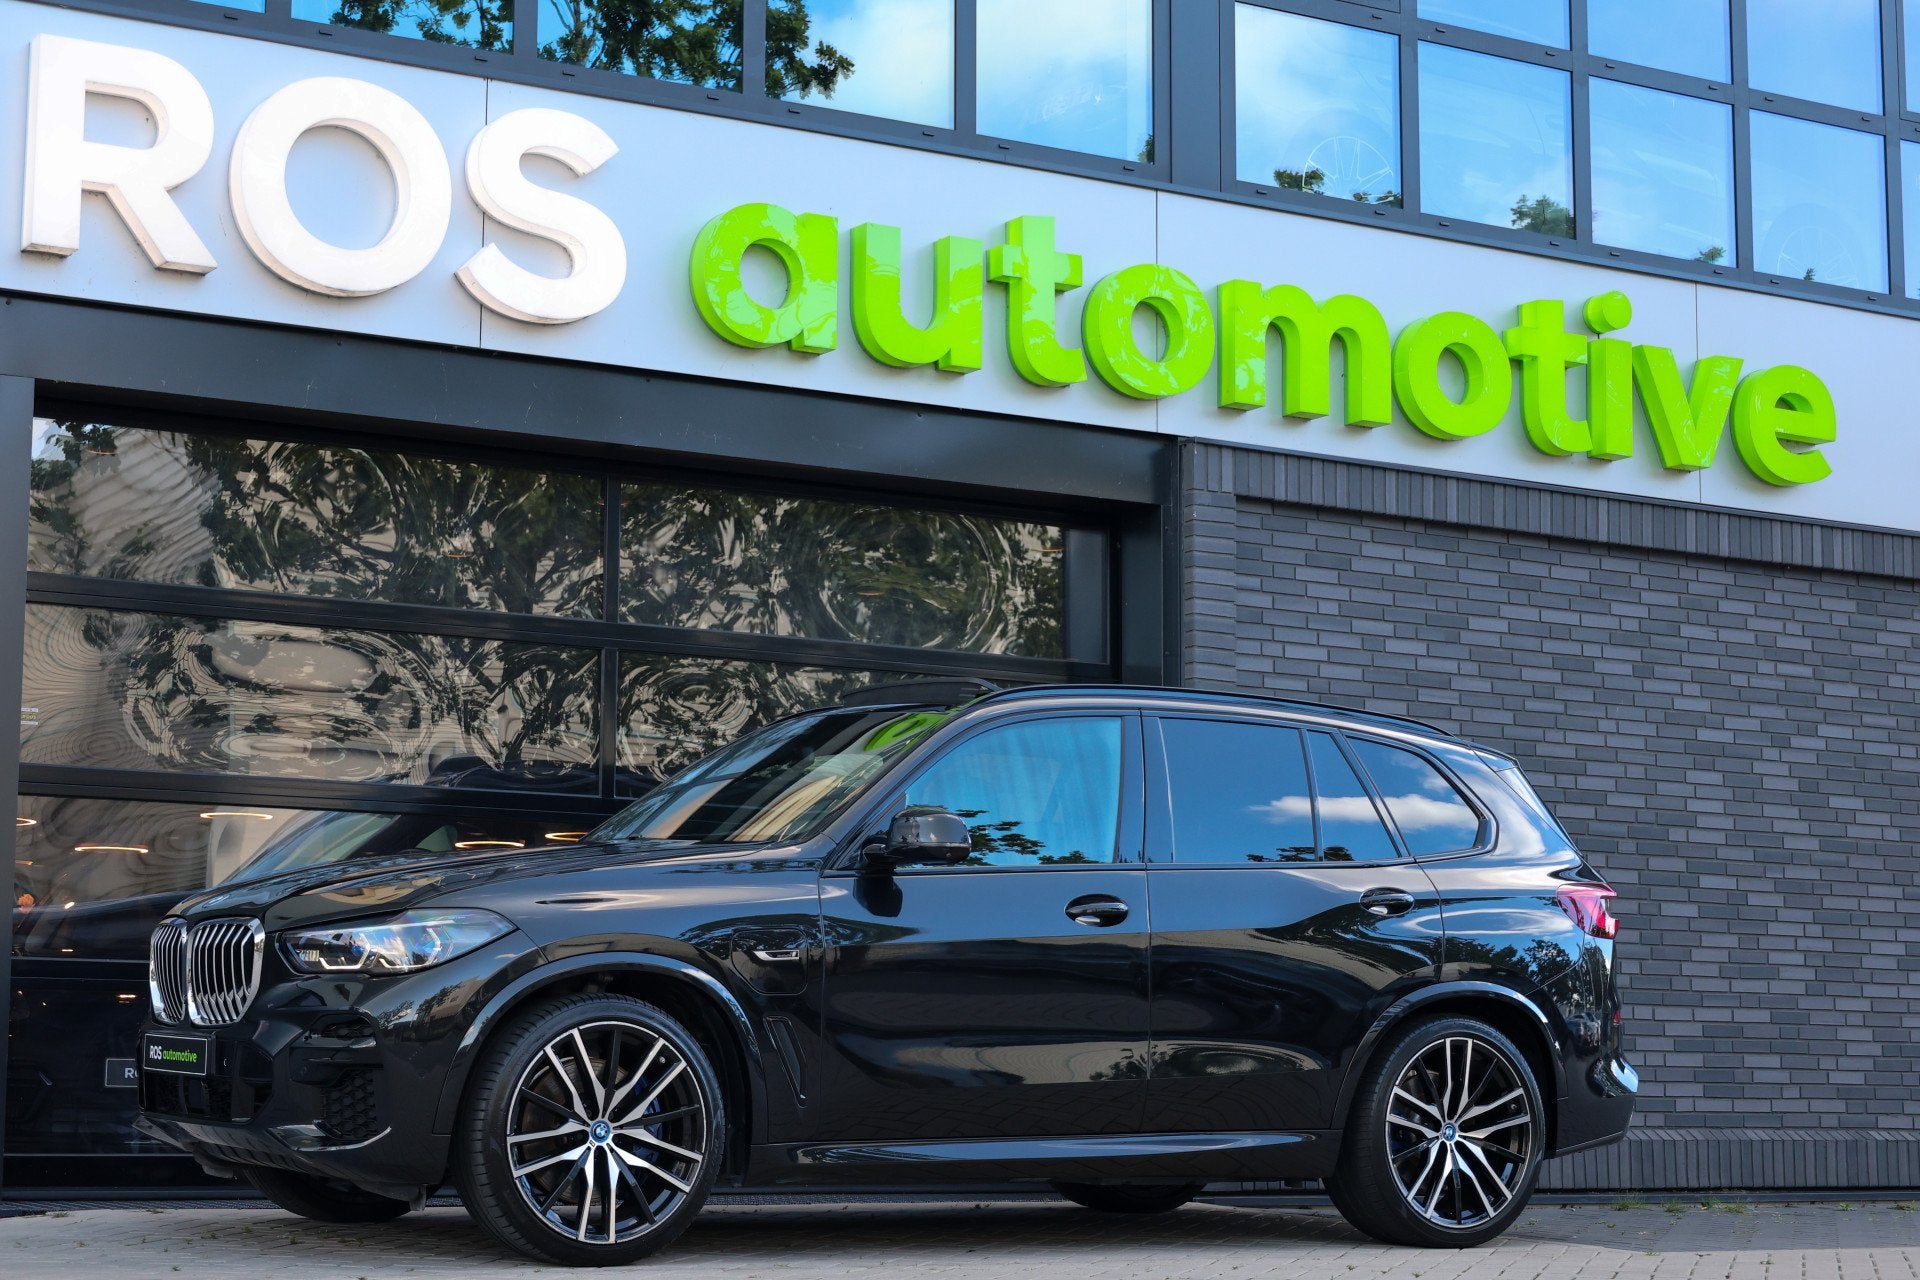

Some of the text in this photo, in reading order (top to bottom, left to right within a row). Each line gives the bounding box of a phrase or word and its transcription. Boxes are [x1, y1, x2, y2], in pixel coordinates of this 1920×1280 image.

[21, 33, 1837, 487] ROS automotive
[150, 1045, 197, 1062] ROS automotive
